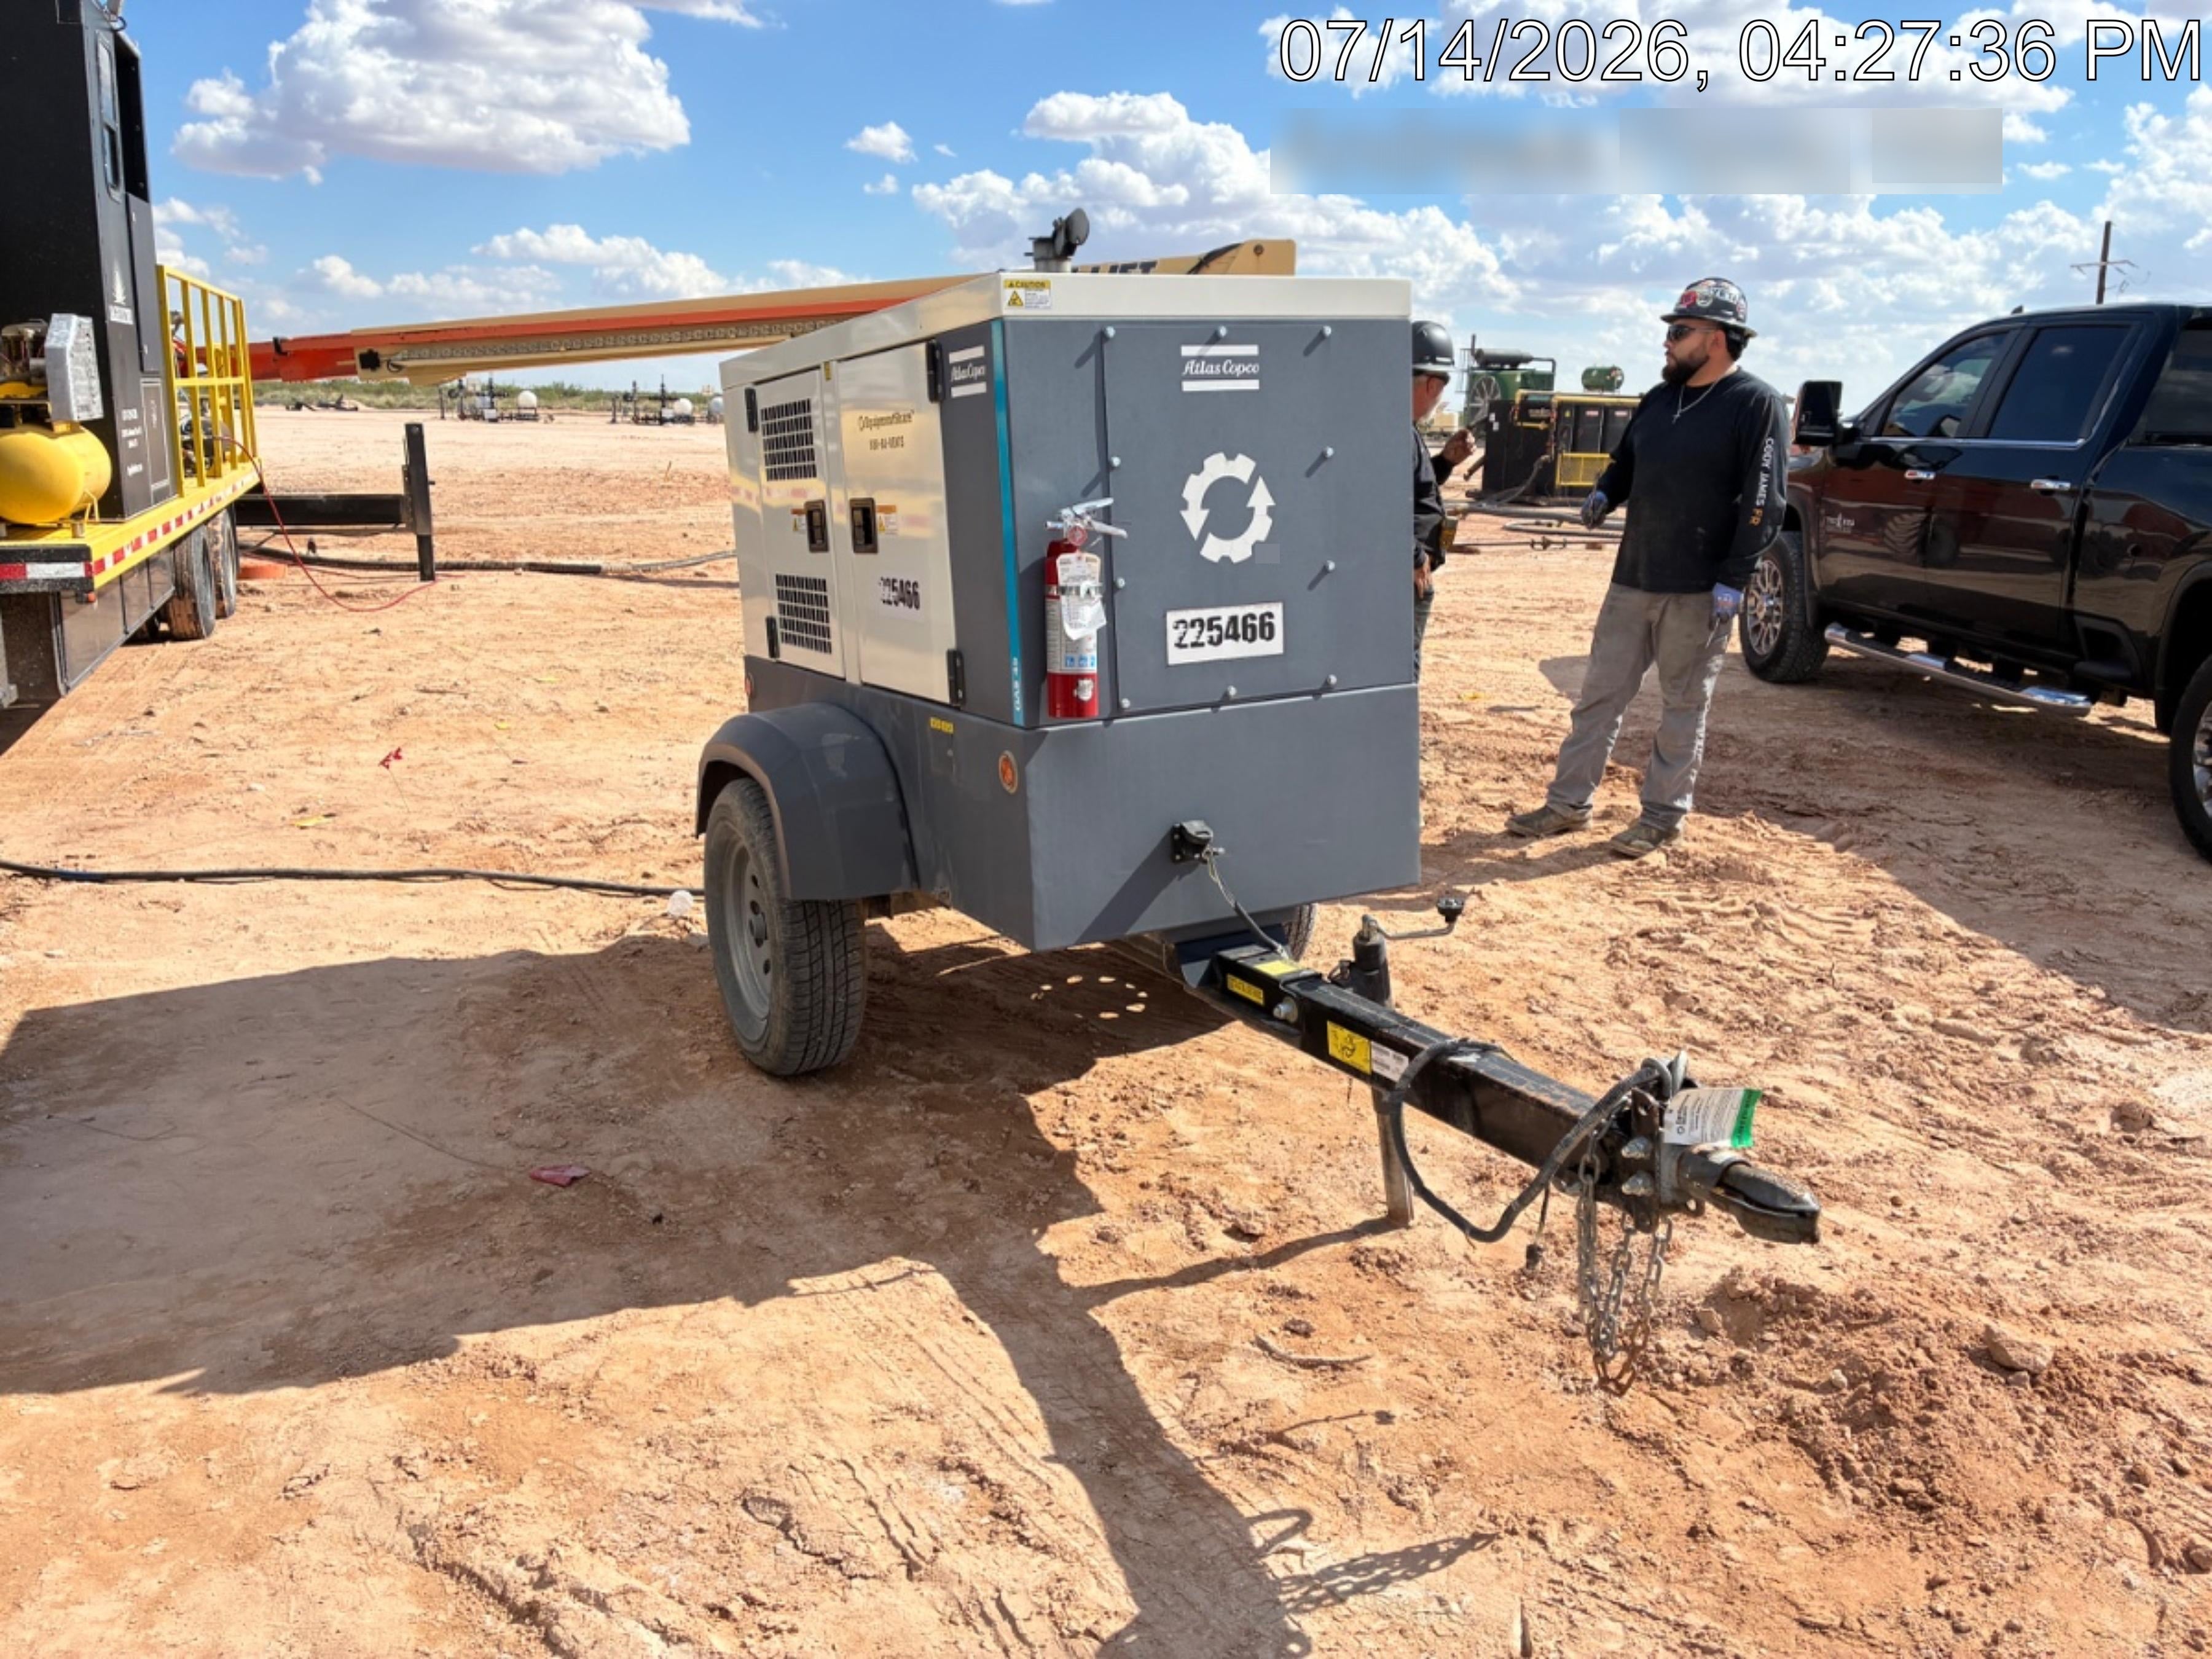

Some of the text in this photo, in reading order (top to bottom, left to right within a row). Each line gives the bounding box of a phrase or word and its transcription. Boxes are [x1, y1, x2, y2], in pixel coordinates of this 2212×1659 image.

[1182, 359, 1259, 378] Atlas Copco
[1762, 437, 1775, 469] CODY
[1755, 471, 1770, 506] JAMES
[1172, 611, 1275, 649] 225466
